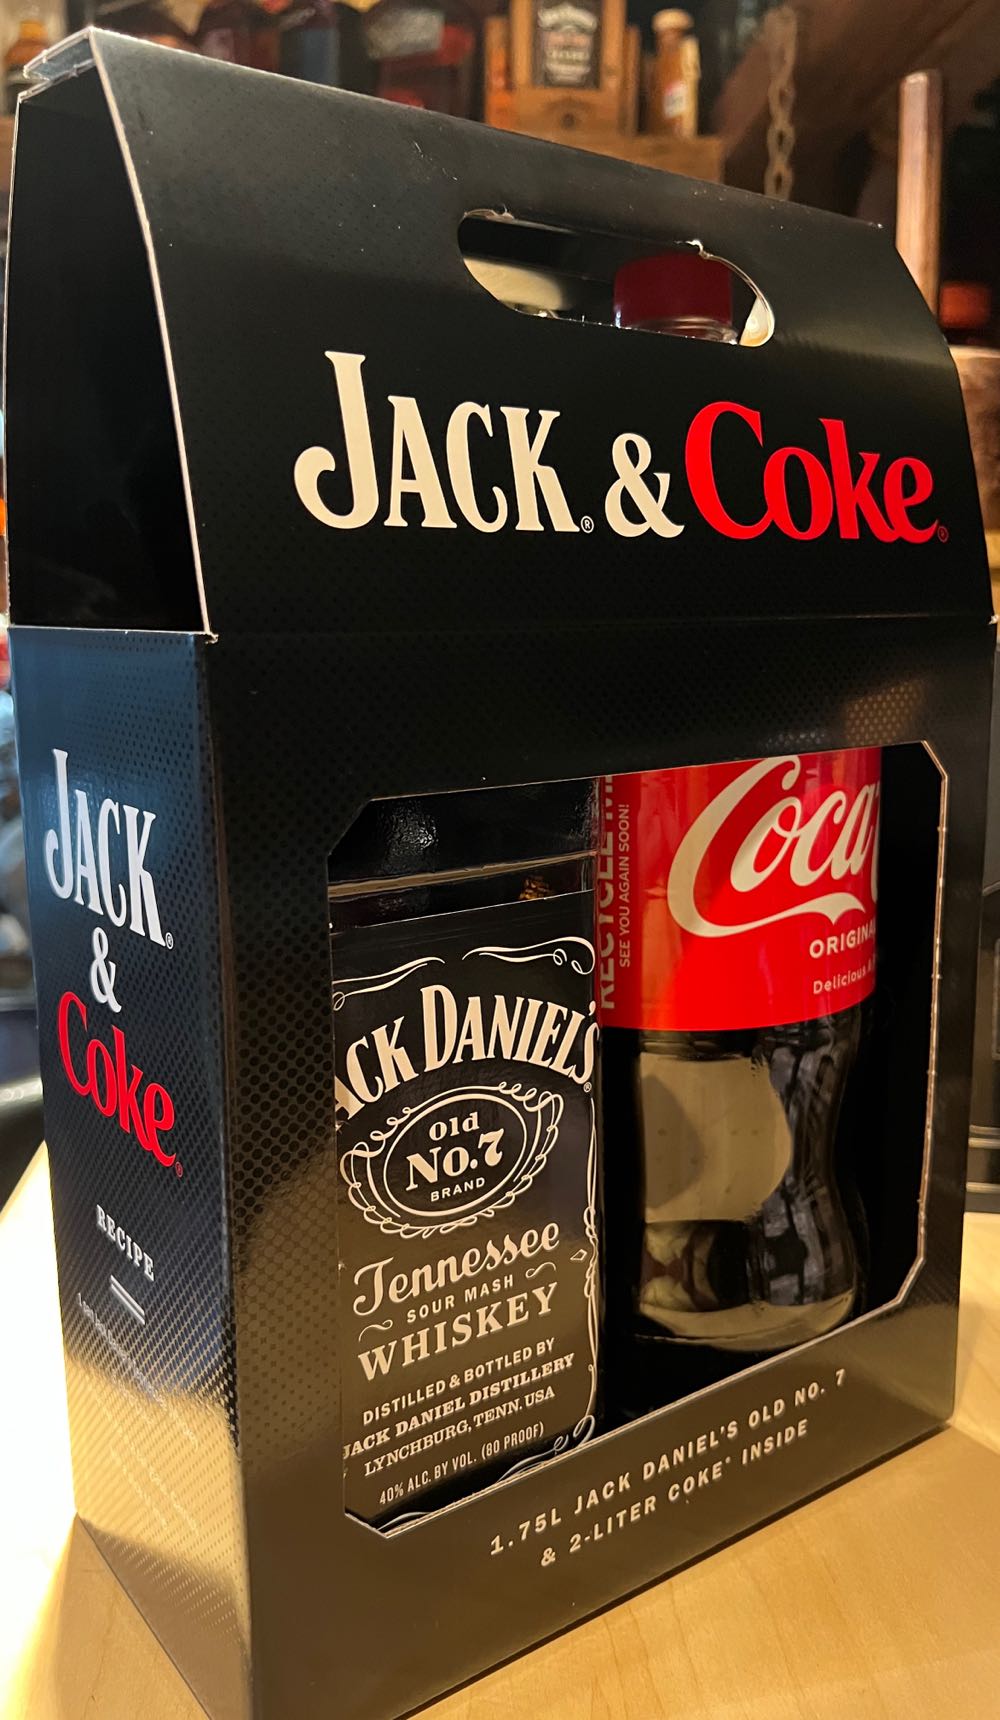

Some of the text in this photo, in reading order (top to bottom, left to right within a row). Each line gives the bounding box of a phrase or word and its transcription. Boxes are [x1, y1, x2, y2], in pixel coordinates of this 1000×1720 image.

[604, 433, 685, 538] &
[685, 401, 939, 544] Coke
[618, 804, 630, 967] SEE YOU AGAIN SOON!
[667, 755, 880, 937] Coca
[90, 927, 122, 1012] &
[809, 916, 876, 959] ORIGINA
[813, 965, 866, 994] Delicious
[58, 991, 176, 1167] Coke
[334, 984, 599, 1120] ACK DANIEL'S
[430, 1177, 485, 1202] BRAND
[96, 1204, 155, 1282] RECIPE
[353, 1223, 559, 1316] Tennessee
[358, 1282, 558, 1381] WHISKEY
[407, 1274, 514, 1323] SOUR MASH
[343, 1353, 575, 1459] JACK DANIEL DISTILLERY
[363, 1337, 556, 1426] DISTILLED & BOTTLED BY
[364, 1385, 556, 1477] LYNCHBURG, TENN. USA
[379, 1421, 545, 1505] 40% ALC. BY VOL. (80 PROOF)
[490, 1368, 845, 1555] 1.75L JACK DANIEL'S OLD NO. 7
[540, 1547, 556, 1567] &
[569, 1495, 657, 1553] 2-LITER
[742, 1419, 808, 1465] INSIDE
